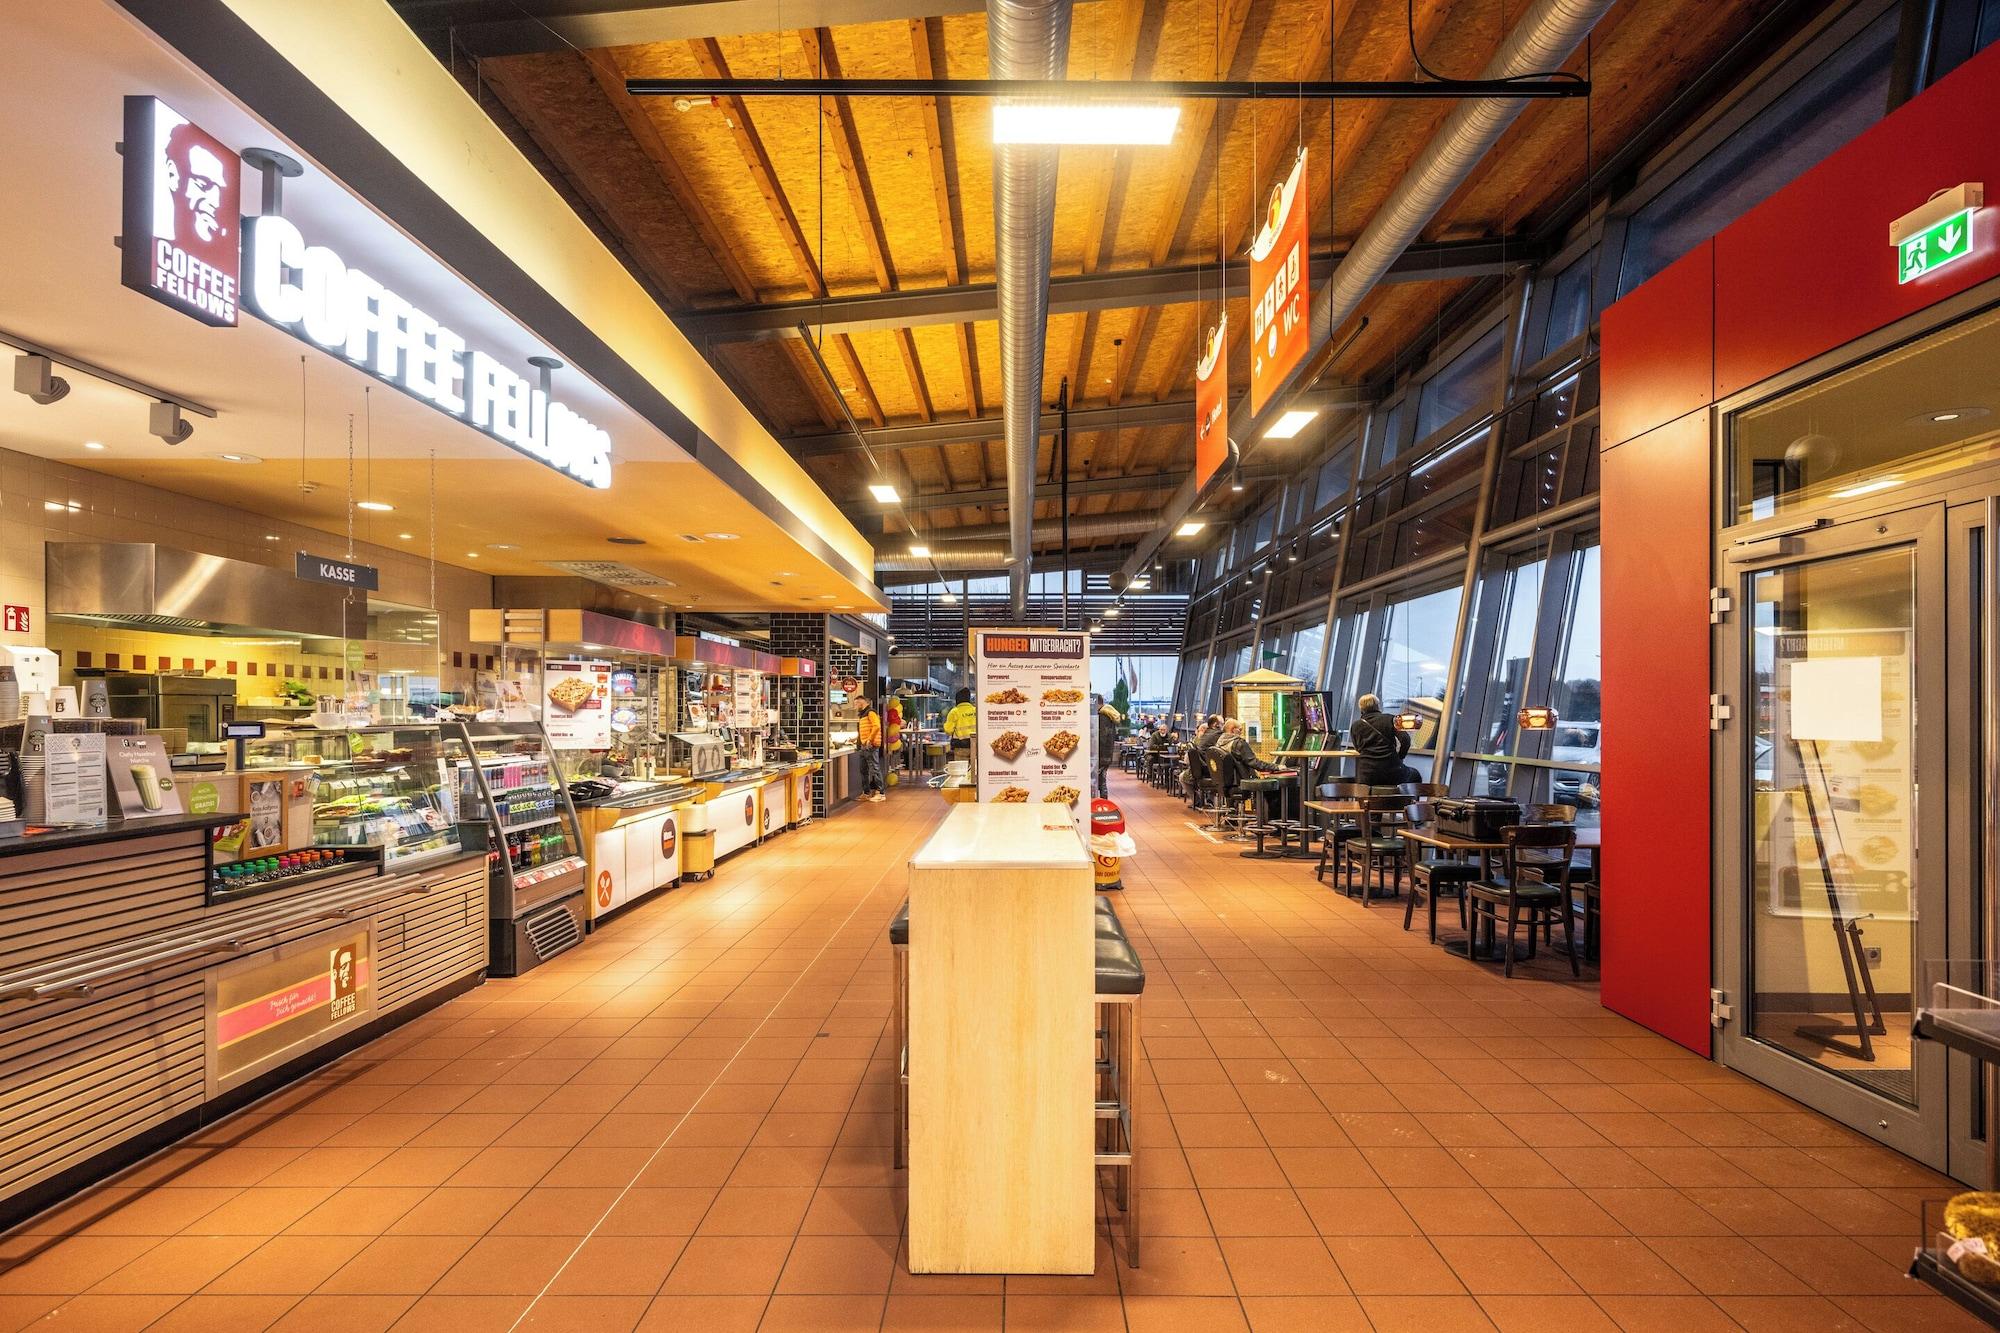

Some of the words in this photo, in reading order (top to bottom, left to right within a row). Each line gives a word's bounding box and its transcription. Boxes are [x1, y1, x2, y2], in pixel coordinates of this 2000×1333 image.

[156, 238, 236, 303] COFFEE
[156, 271, 236, 325] FELLOWS
[1283, 293, 1300, 336] WC
[253, 215, 465, 414] COFFEE
[470, 351, 612, 489] FELLOWS
[320, 563, 356, 583] KASSE
[986, 637, 1028, 652] HUNGER
[1029, 638, 1081, 653] MITGEBRACHT?
[330, 1003, 356, 1021] FELLOWS
[331, 993, 355, 1012] COFFEE
